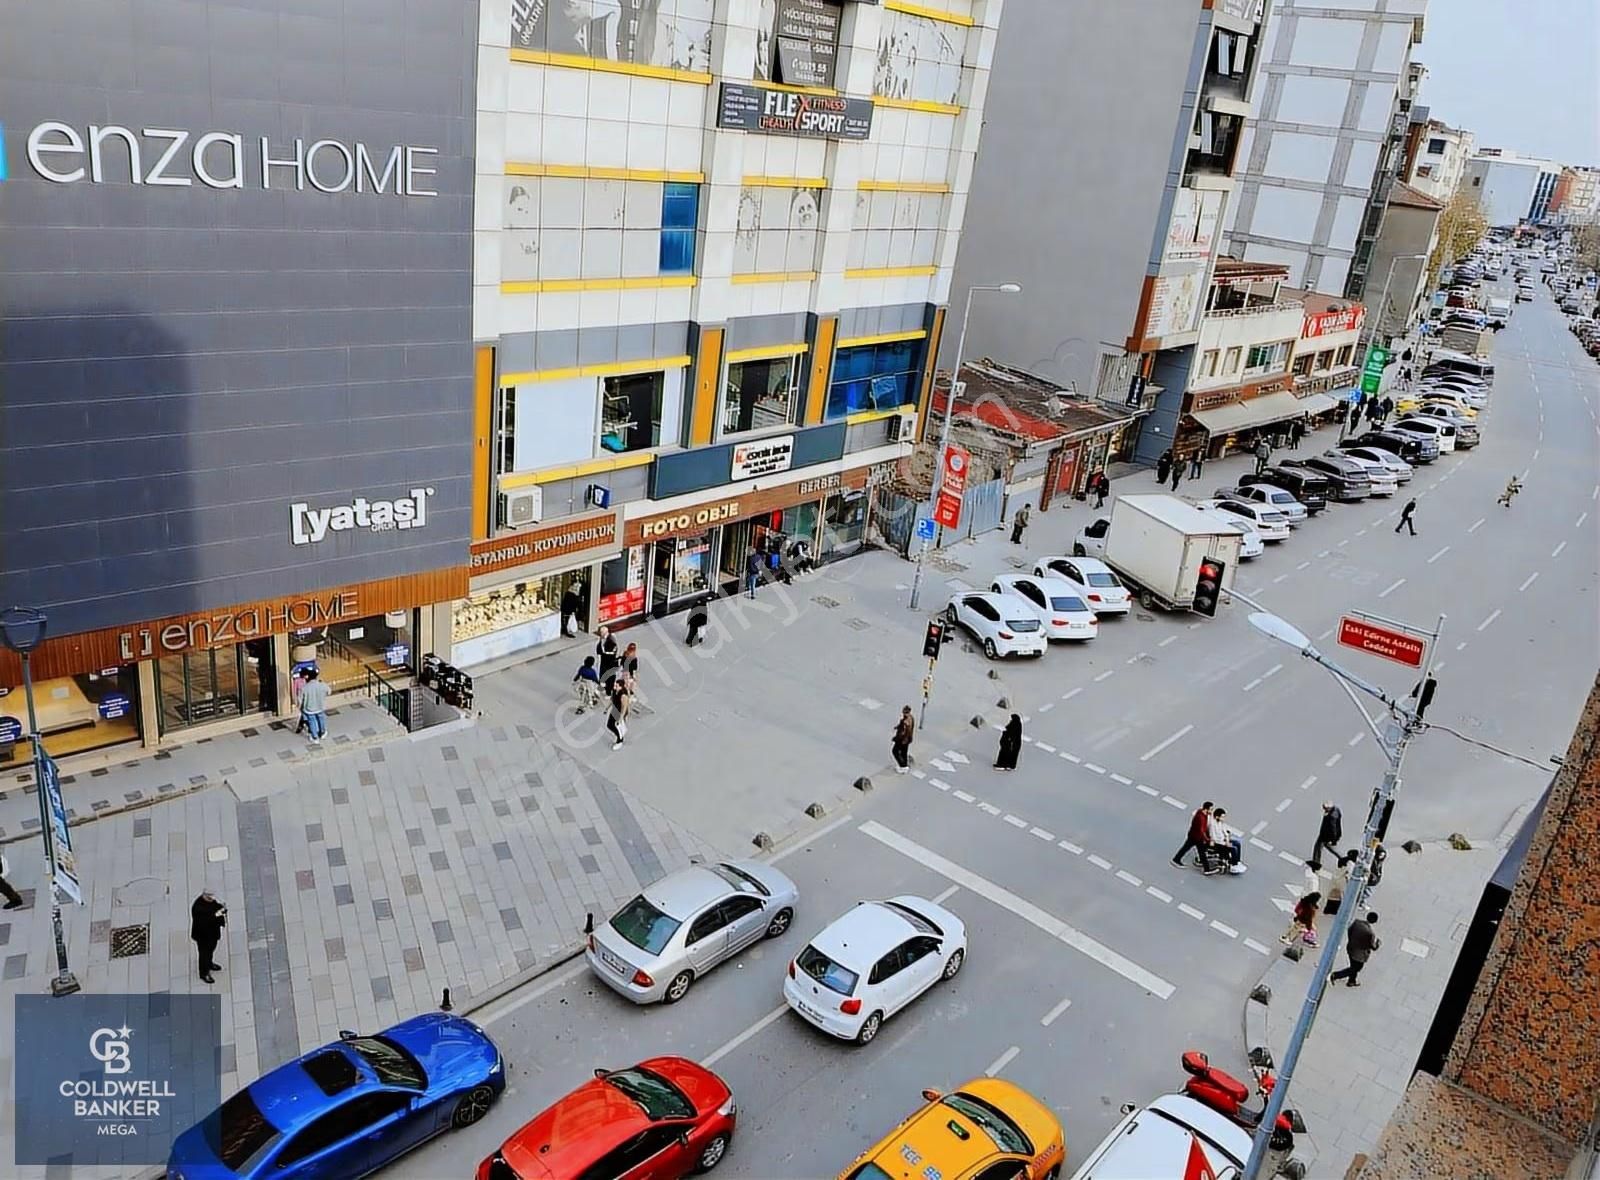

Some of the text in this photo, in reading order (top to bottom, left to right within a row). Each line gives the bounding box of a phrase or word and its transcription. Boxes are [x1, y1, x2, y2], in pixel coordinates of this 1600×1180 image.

[764, 91, 809, 122] FLEX
[801, 112, 845, 132] SPORT
[27, 119, 438, 197] enza HOME
[800, 475, 841, 495] BERBER
[643, 502, 739, 538] FOTO OBJE
[534, 524, 615, 553] KUYUMCULUK
[161, 591, 359, 651] enza HOME
[1344, 624, 1363, 635] Eski
[1363, 630, 1391, 645] Edirne
[1363, 639, 1397, 656] Caddesi
